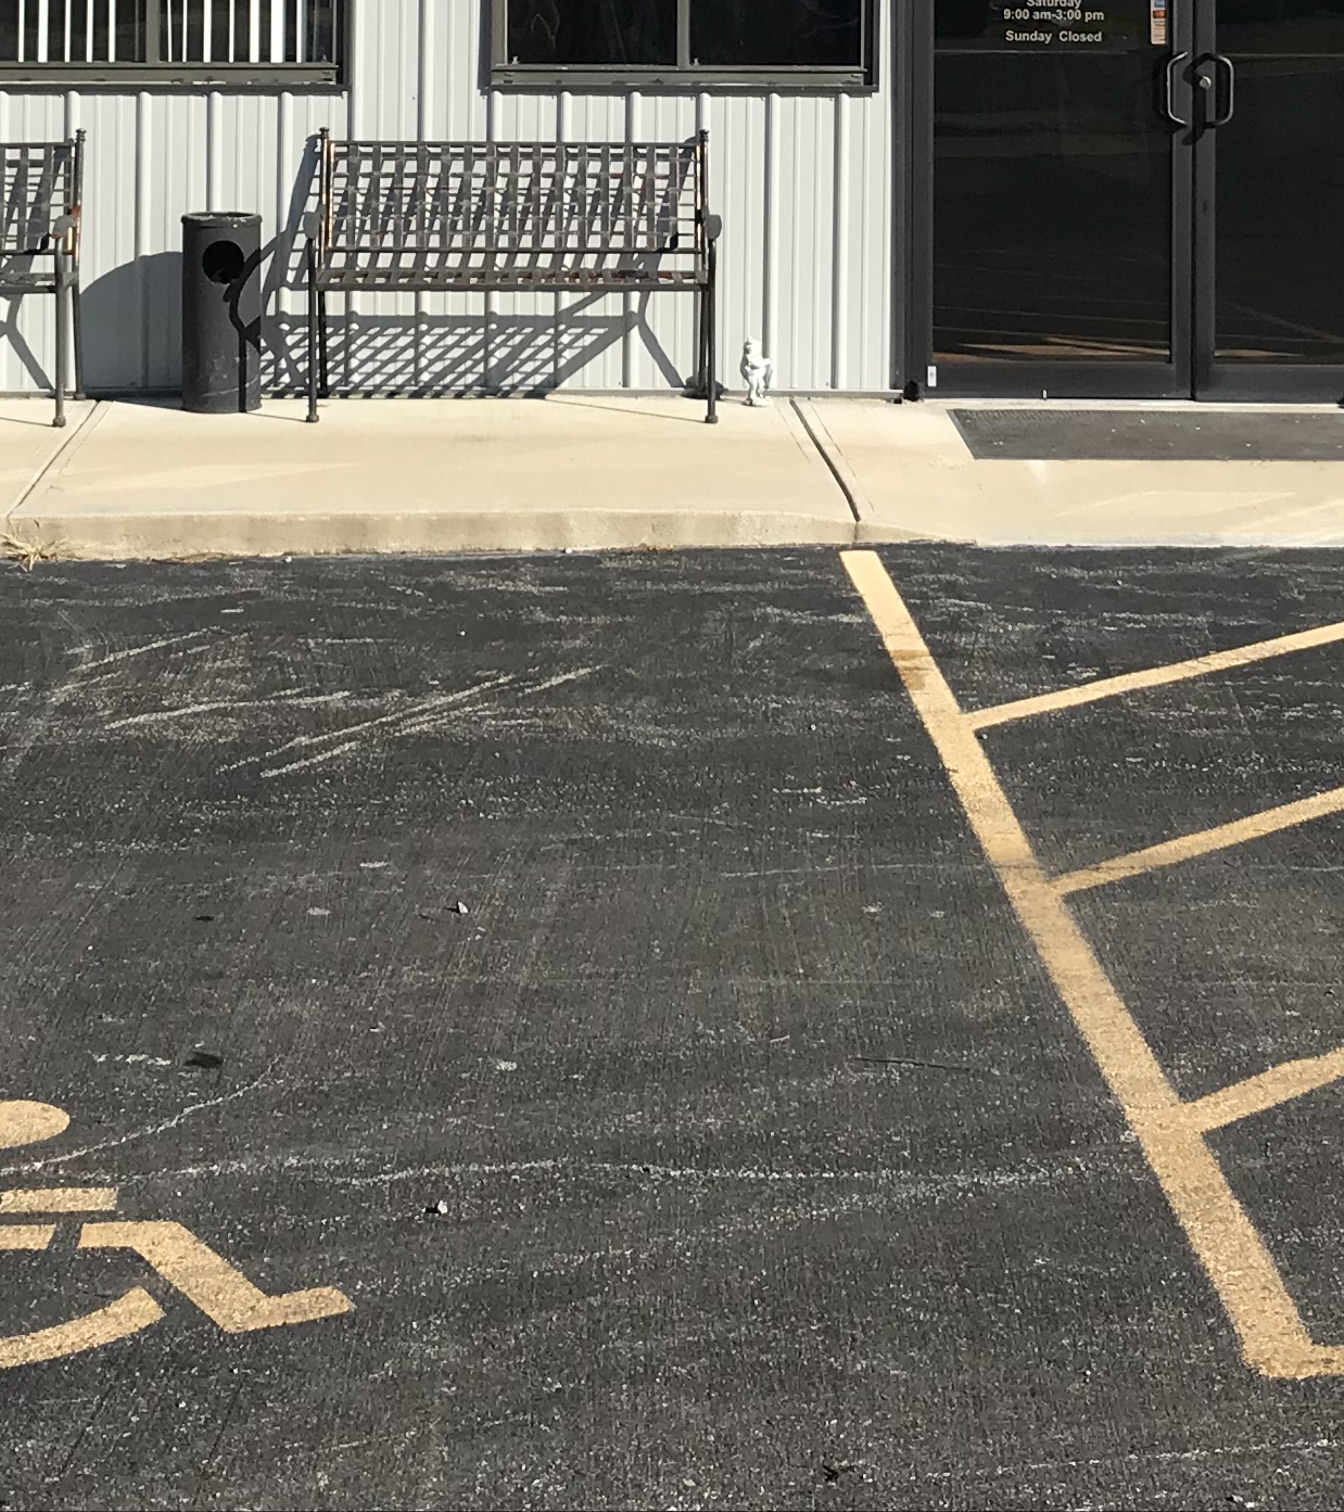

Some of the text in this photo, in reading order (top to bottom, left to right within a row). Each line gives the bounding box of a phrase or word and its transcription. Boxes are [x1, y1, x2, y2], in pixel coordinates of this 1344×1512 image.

[1003, 9, 1105, 23] 9:00 am-3:00 pm
[1005, 30, 1102, 44] Sunday Closed
